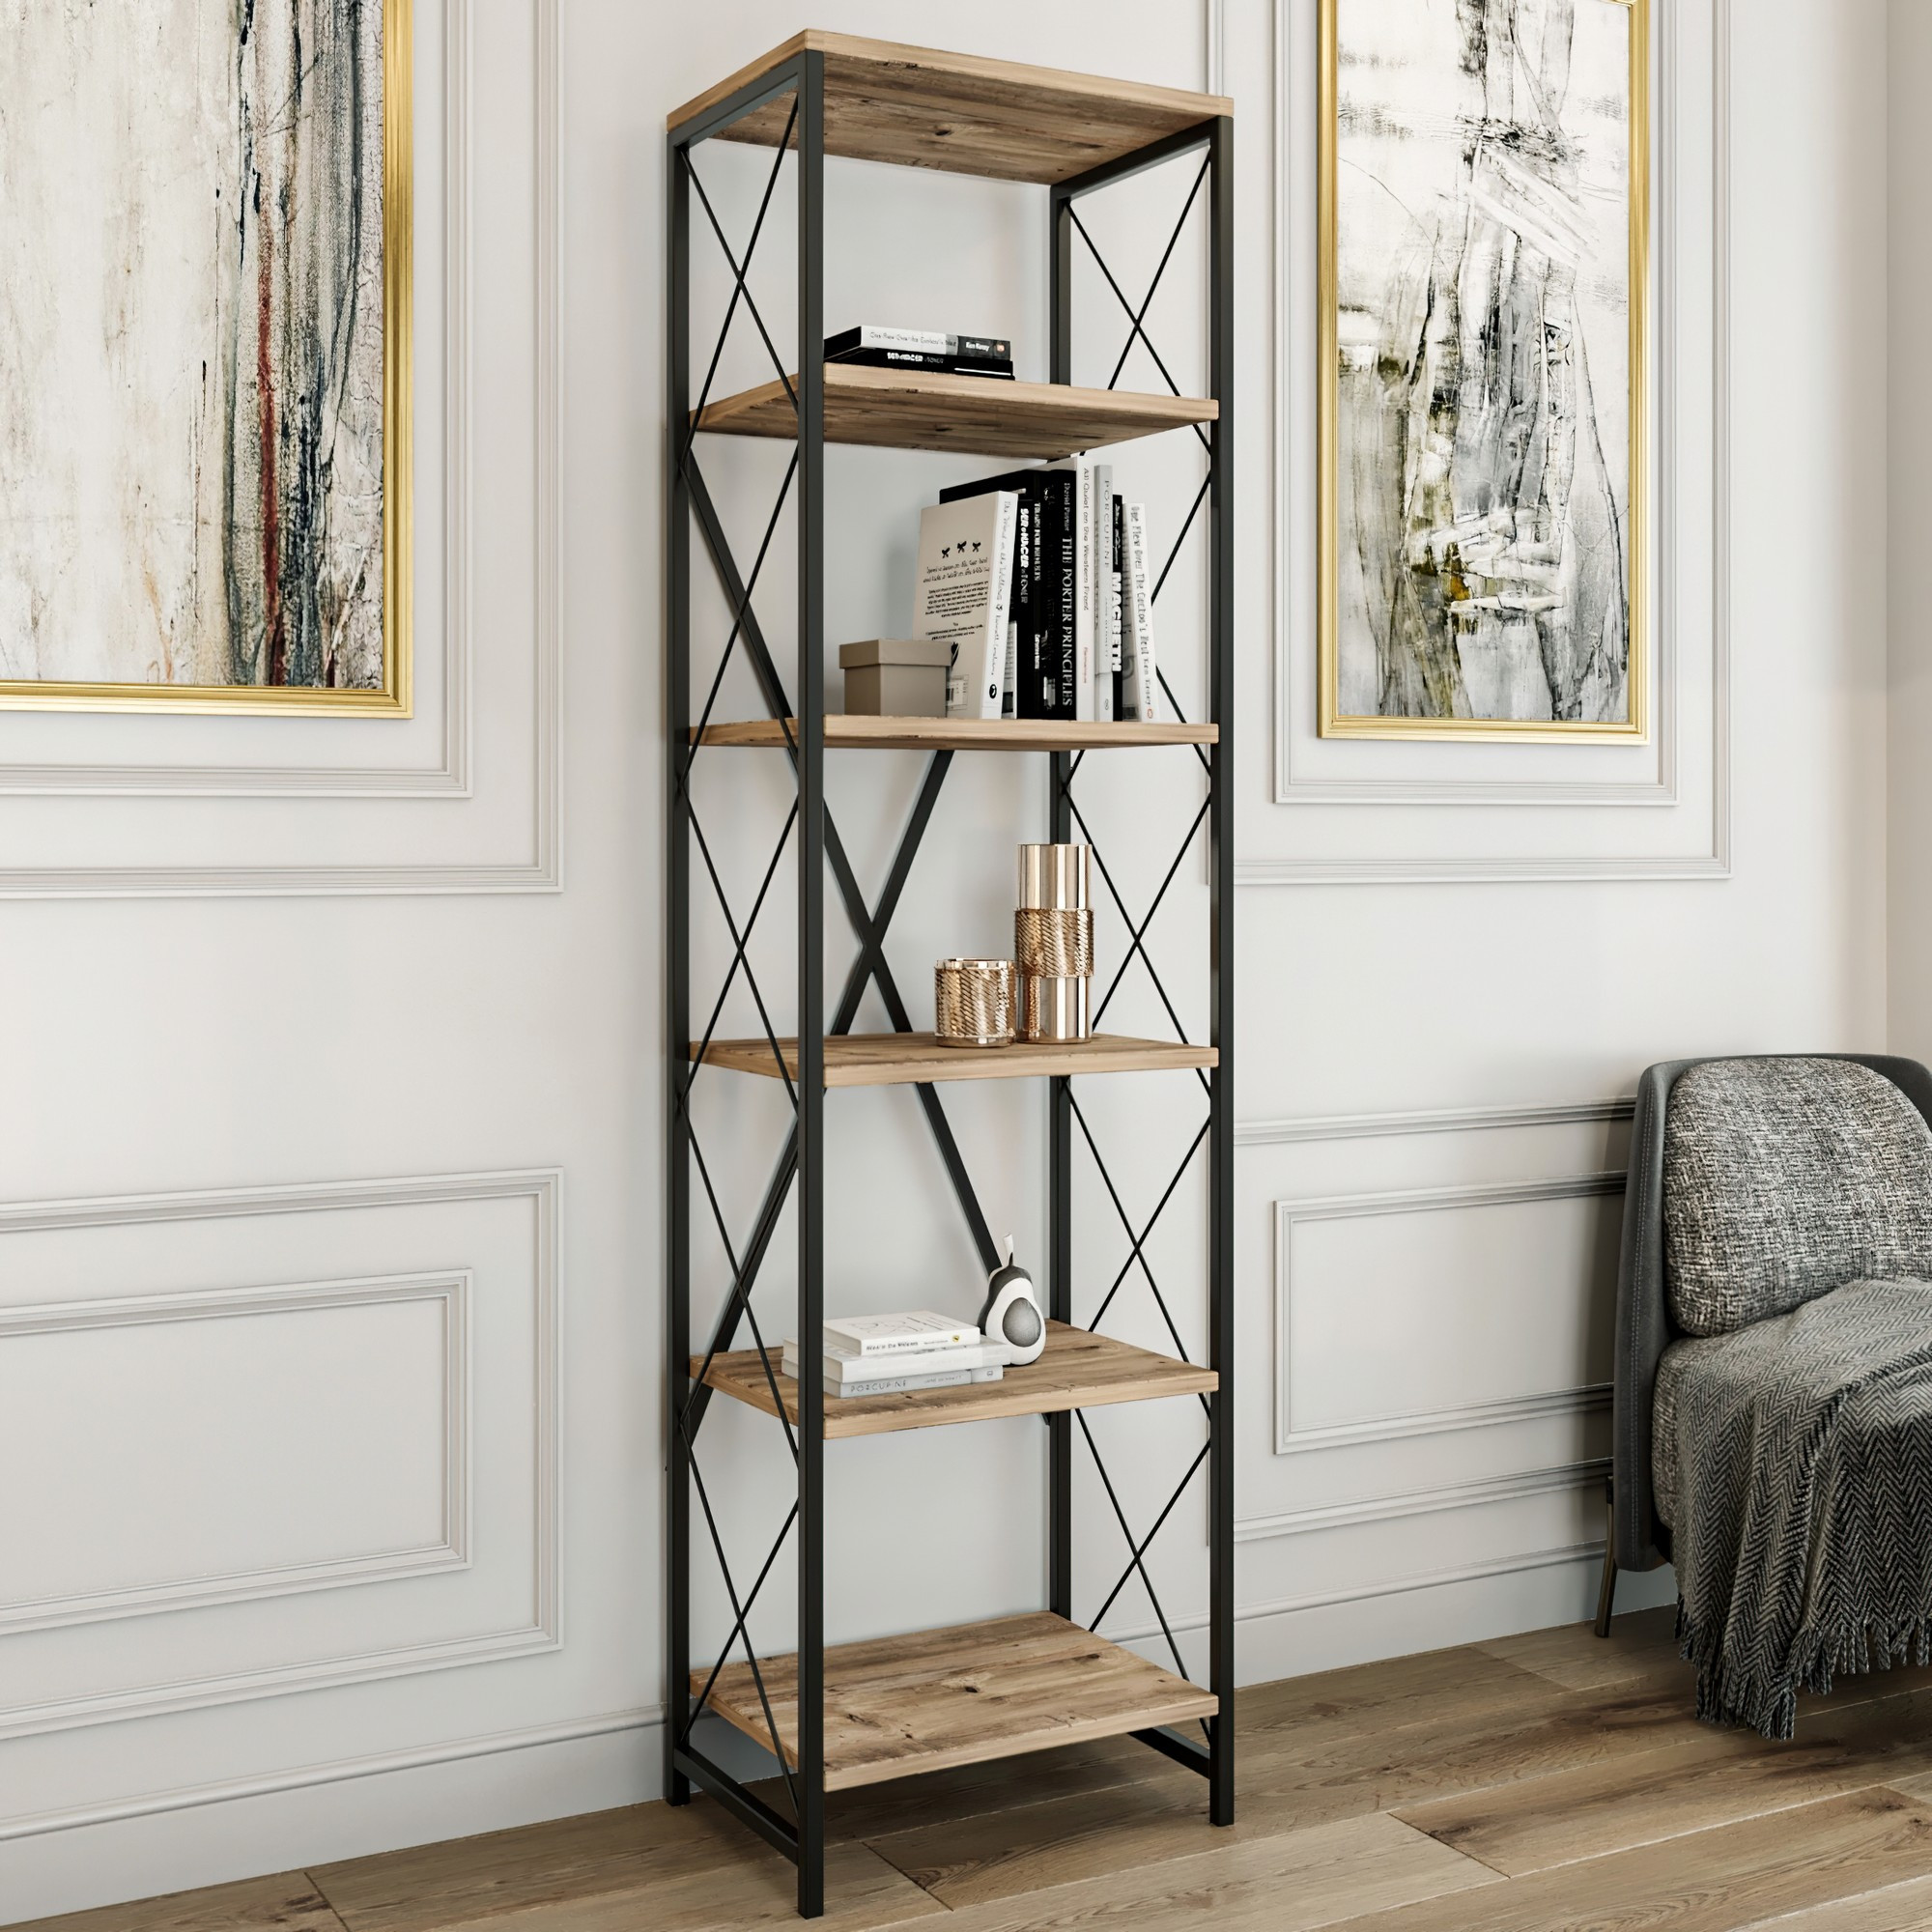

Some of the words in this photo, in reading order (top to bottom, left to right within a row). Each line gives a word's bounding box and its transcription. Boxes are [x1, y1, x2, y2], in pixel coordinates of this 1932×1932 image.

[1083, 511, 1089, 524] on
[1062, 536, 1072, 564] THE
[1132, 526, 1142, 547] Flew
[1134, 549, 1143, 570] Over
[1062, 568, 1072, 623] PORTER
[1112, 572, 1122, 671] MACBETH
[1062, 626, 1073, 706] PRINCIPLES
